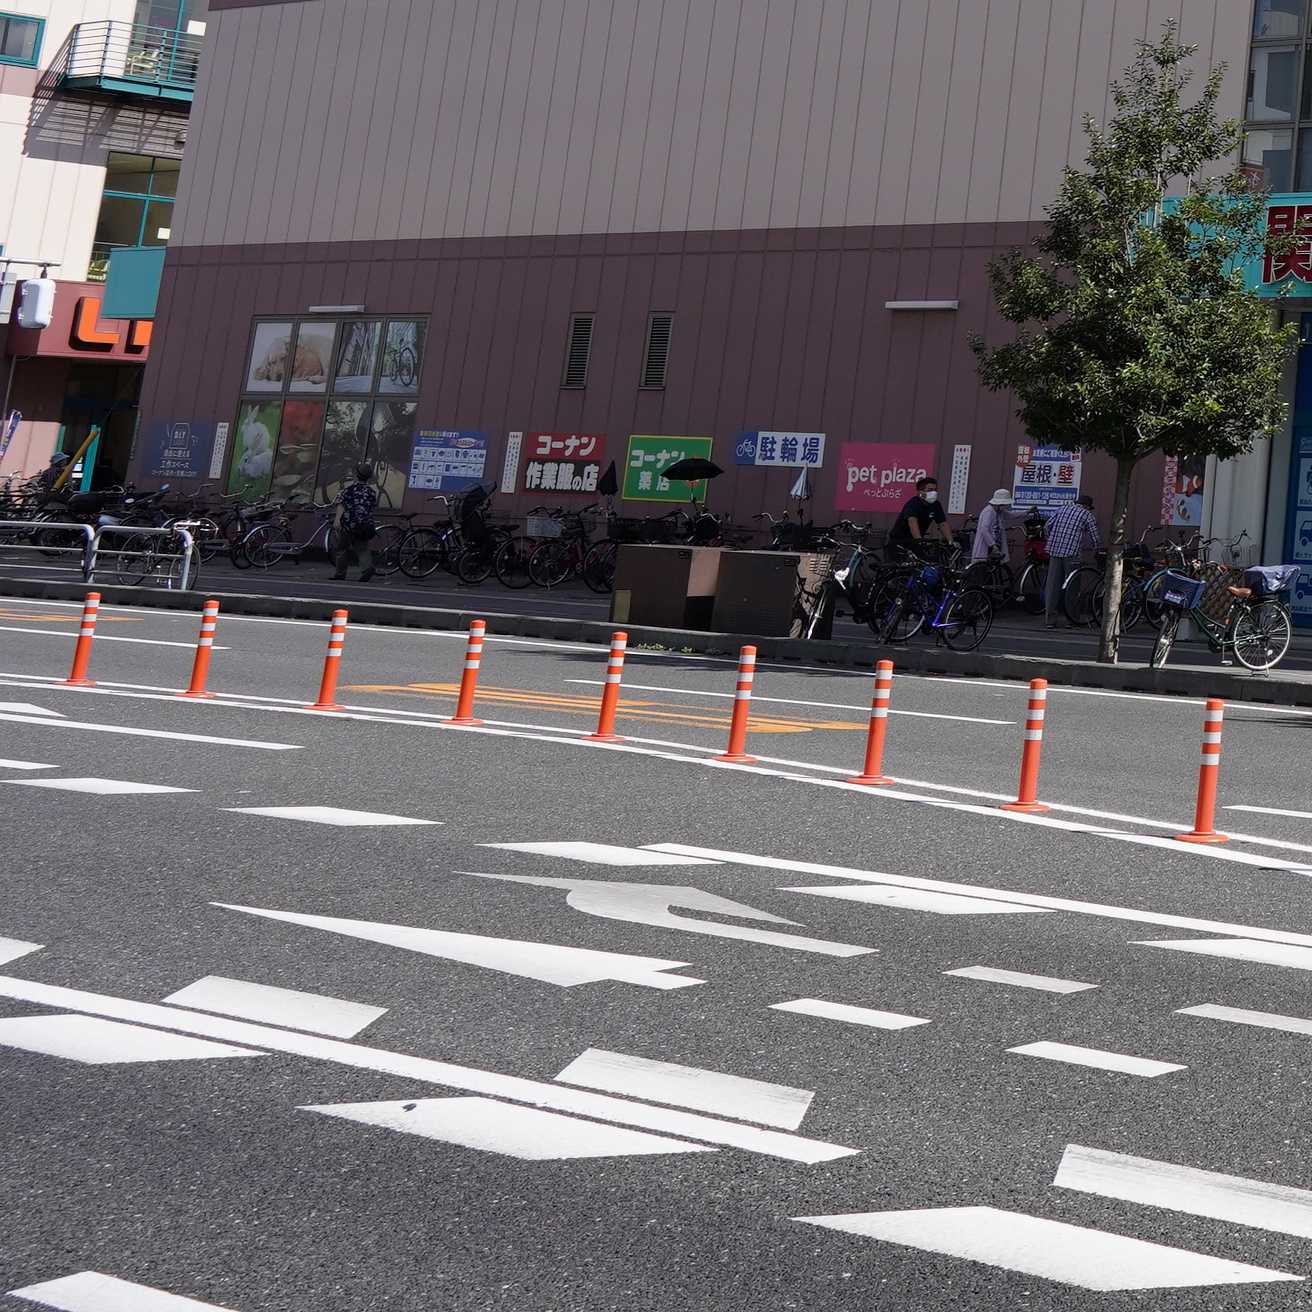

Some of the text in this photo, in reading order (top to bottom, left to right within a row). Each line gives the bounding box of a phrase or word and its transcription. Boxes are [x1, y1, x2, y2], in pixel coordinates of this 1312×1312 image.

[536, 435, 596, 456] コーナン
[760, 436, 819, 464] 駐輪場
[631, 449, 686, 468] コーナン
[526, 461, 599, 491] 作業服の店
[846, 463, 927, 492] pet plaza
[1021, 464, 1074, 484] 屋根・壁
